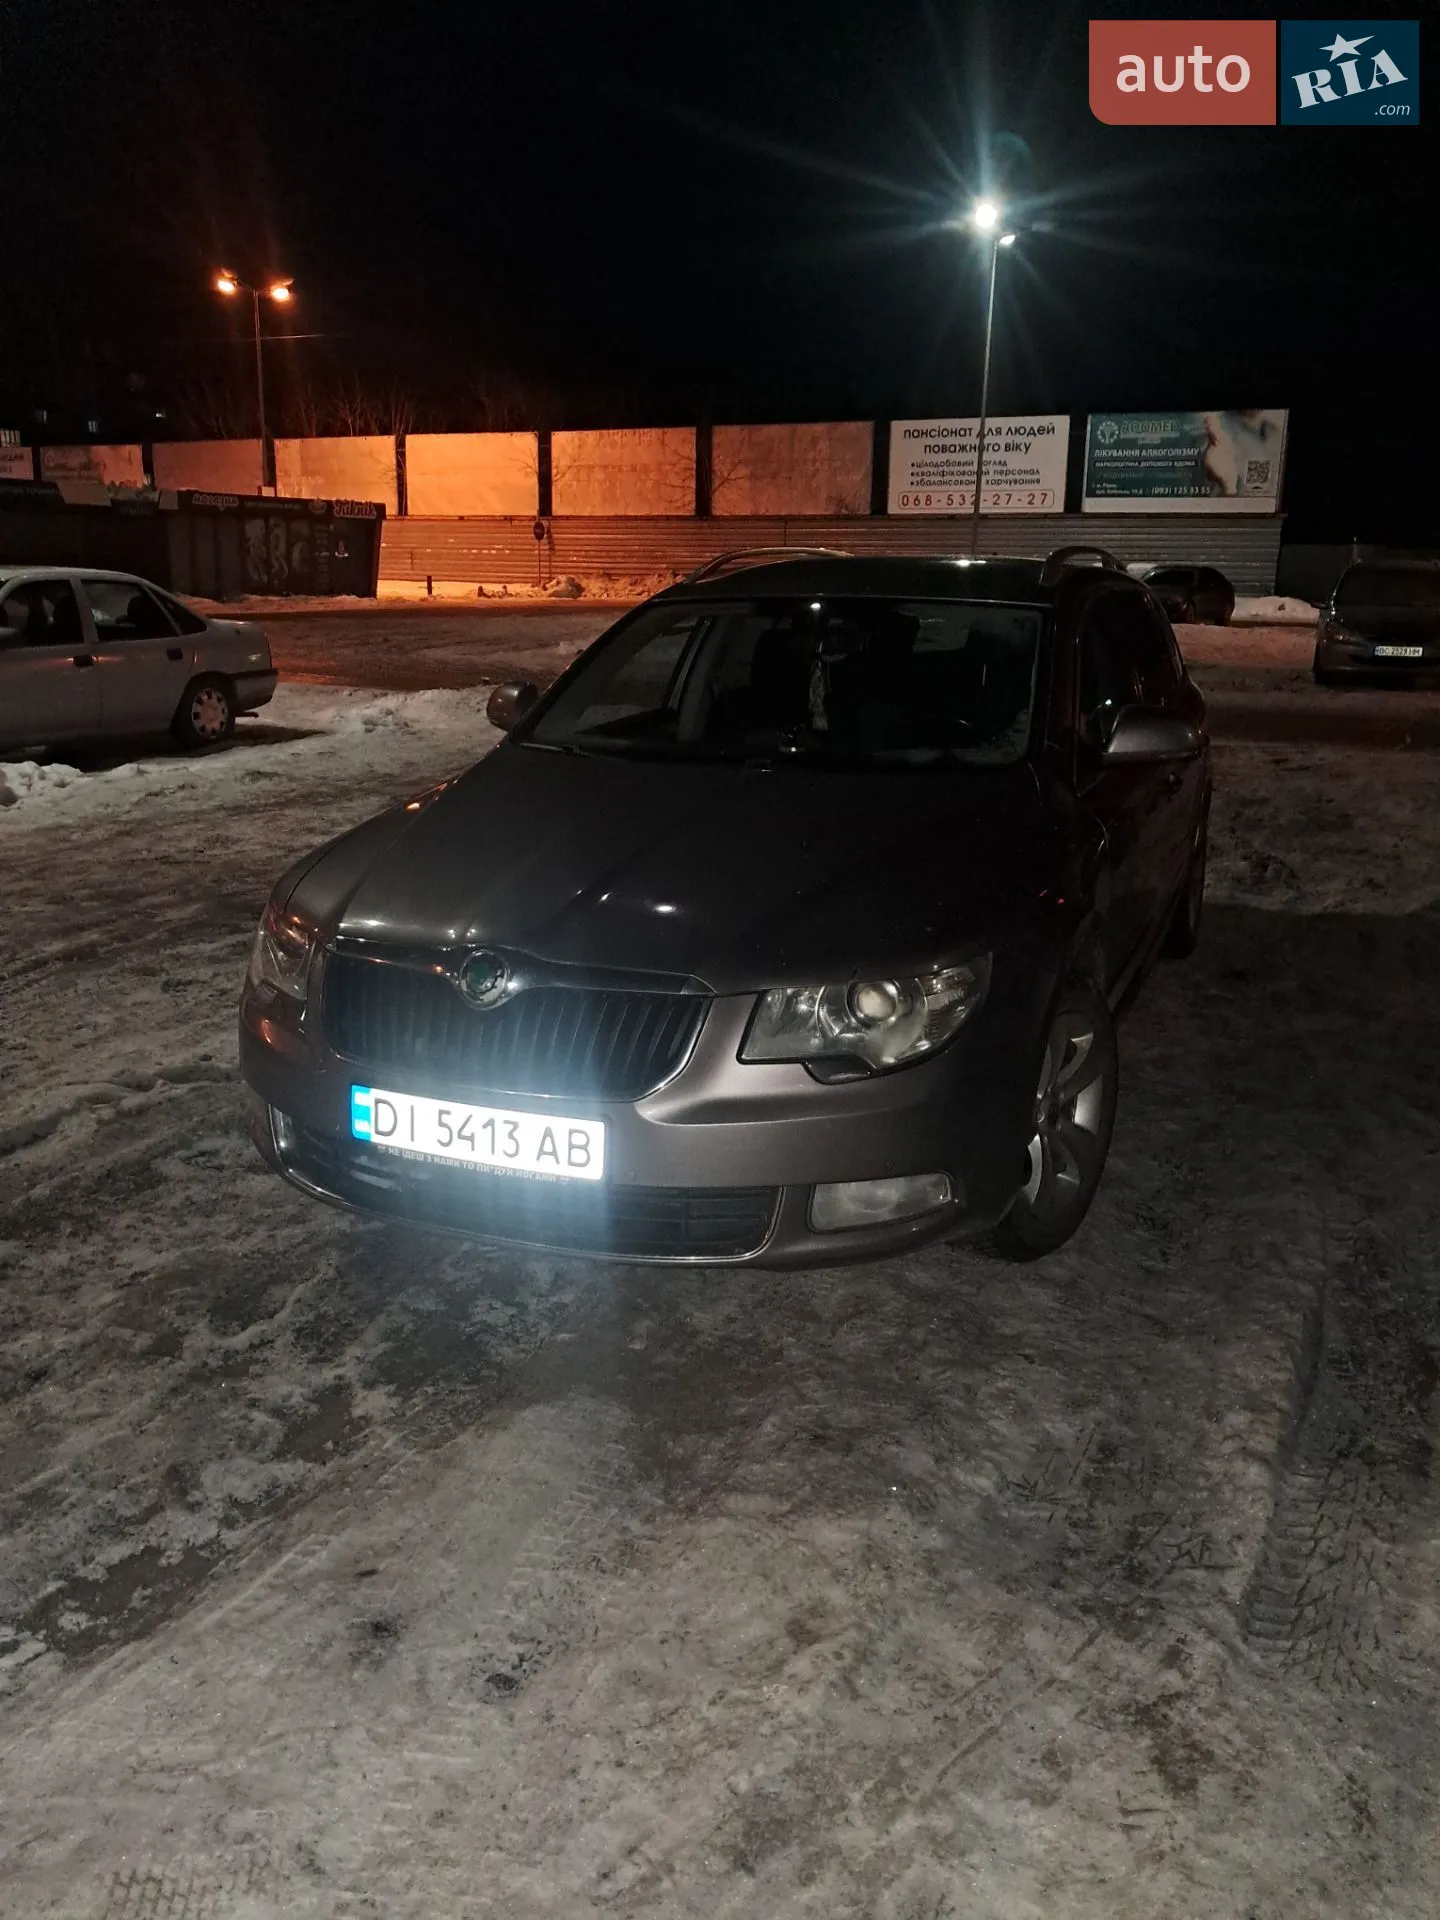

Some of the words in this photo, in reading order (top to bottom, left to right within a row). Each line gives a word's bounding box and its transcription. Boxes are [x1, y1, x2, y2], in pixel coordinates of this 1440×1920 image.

[903, 425, 974, 439] пансіонат
[1006, 422, 1056, 437] людей
[1004, 440, 1032, 454] віку
[1142, 448, 1199, 457] АЛКОГОЛІЗМУ
[916, 460, 974, 468] цілодобовий
[915, 478, 980, 486] збалансован
[374, 1098, 416, 1143] DI
[437, 1109, 520, 1159] 5413
[536, 1126, 591, 1168] AB
[461, 1160, 475, 1170] ТО
